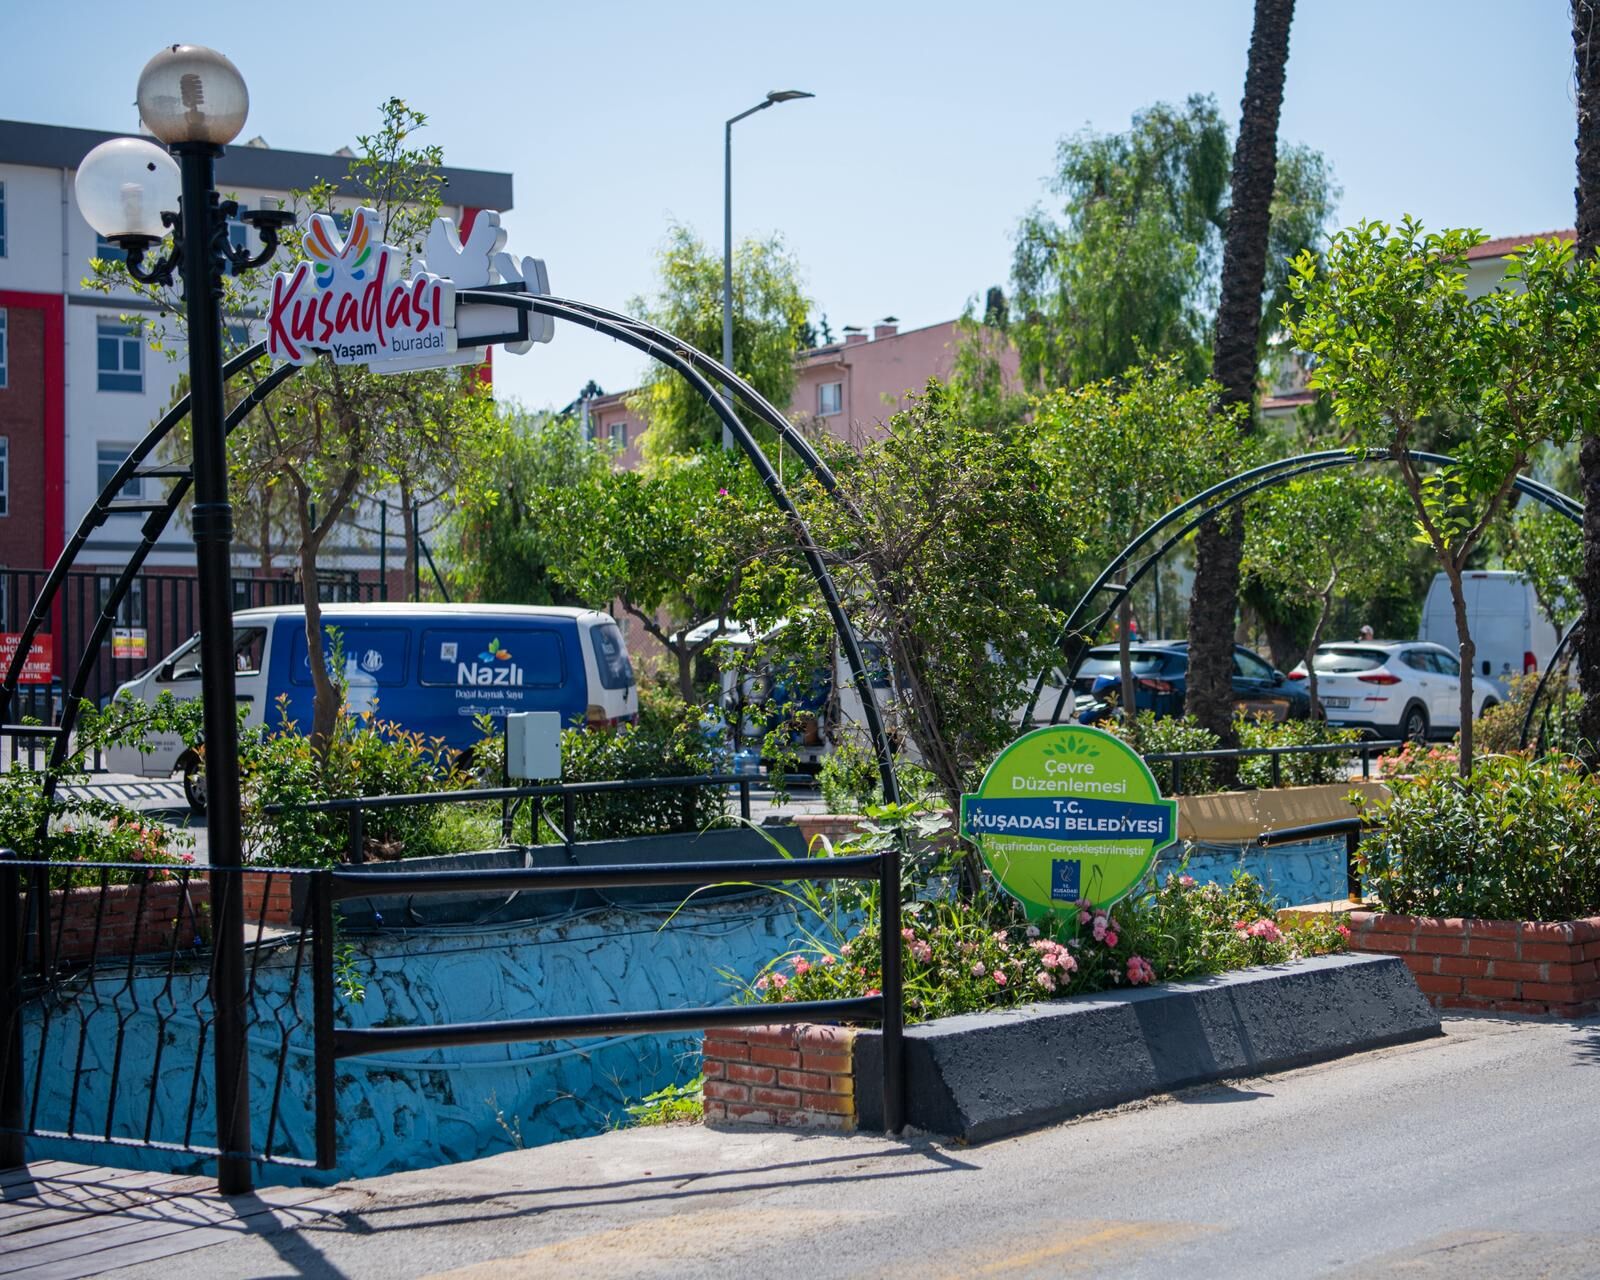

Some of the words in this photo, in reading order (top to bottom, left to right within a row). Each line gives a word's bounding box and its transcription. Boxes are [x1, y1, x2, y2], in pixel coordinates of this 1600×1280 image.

[269, 251, 441, 361] Kuşadası
[332, 343, 377, 362] Yaşam
[392, 335, 444, 352] burada!
[457, 662, 523, 686] Nazlı
[455, 689, 476, 699] Doğal
[477, 689, 504, 700] Kaynak
[506, 690, 524, 701] Suyu
[1044, 759, 1095, 776] Çevre
[1012, 776, 1127, 794] Düzenlemesi
[1053, 801, 1083, 814] T.C.
[973, 814, 1059, 831] KUŞADASI
[1065, 815, 1163, 833] BELEDİYESİ
[990, 841, 1046, 852] Tarafından
[1048, 842, 1146, 857] Gerçekleştirilmiştir
